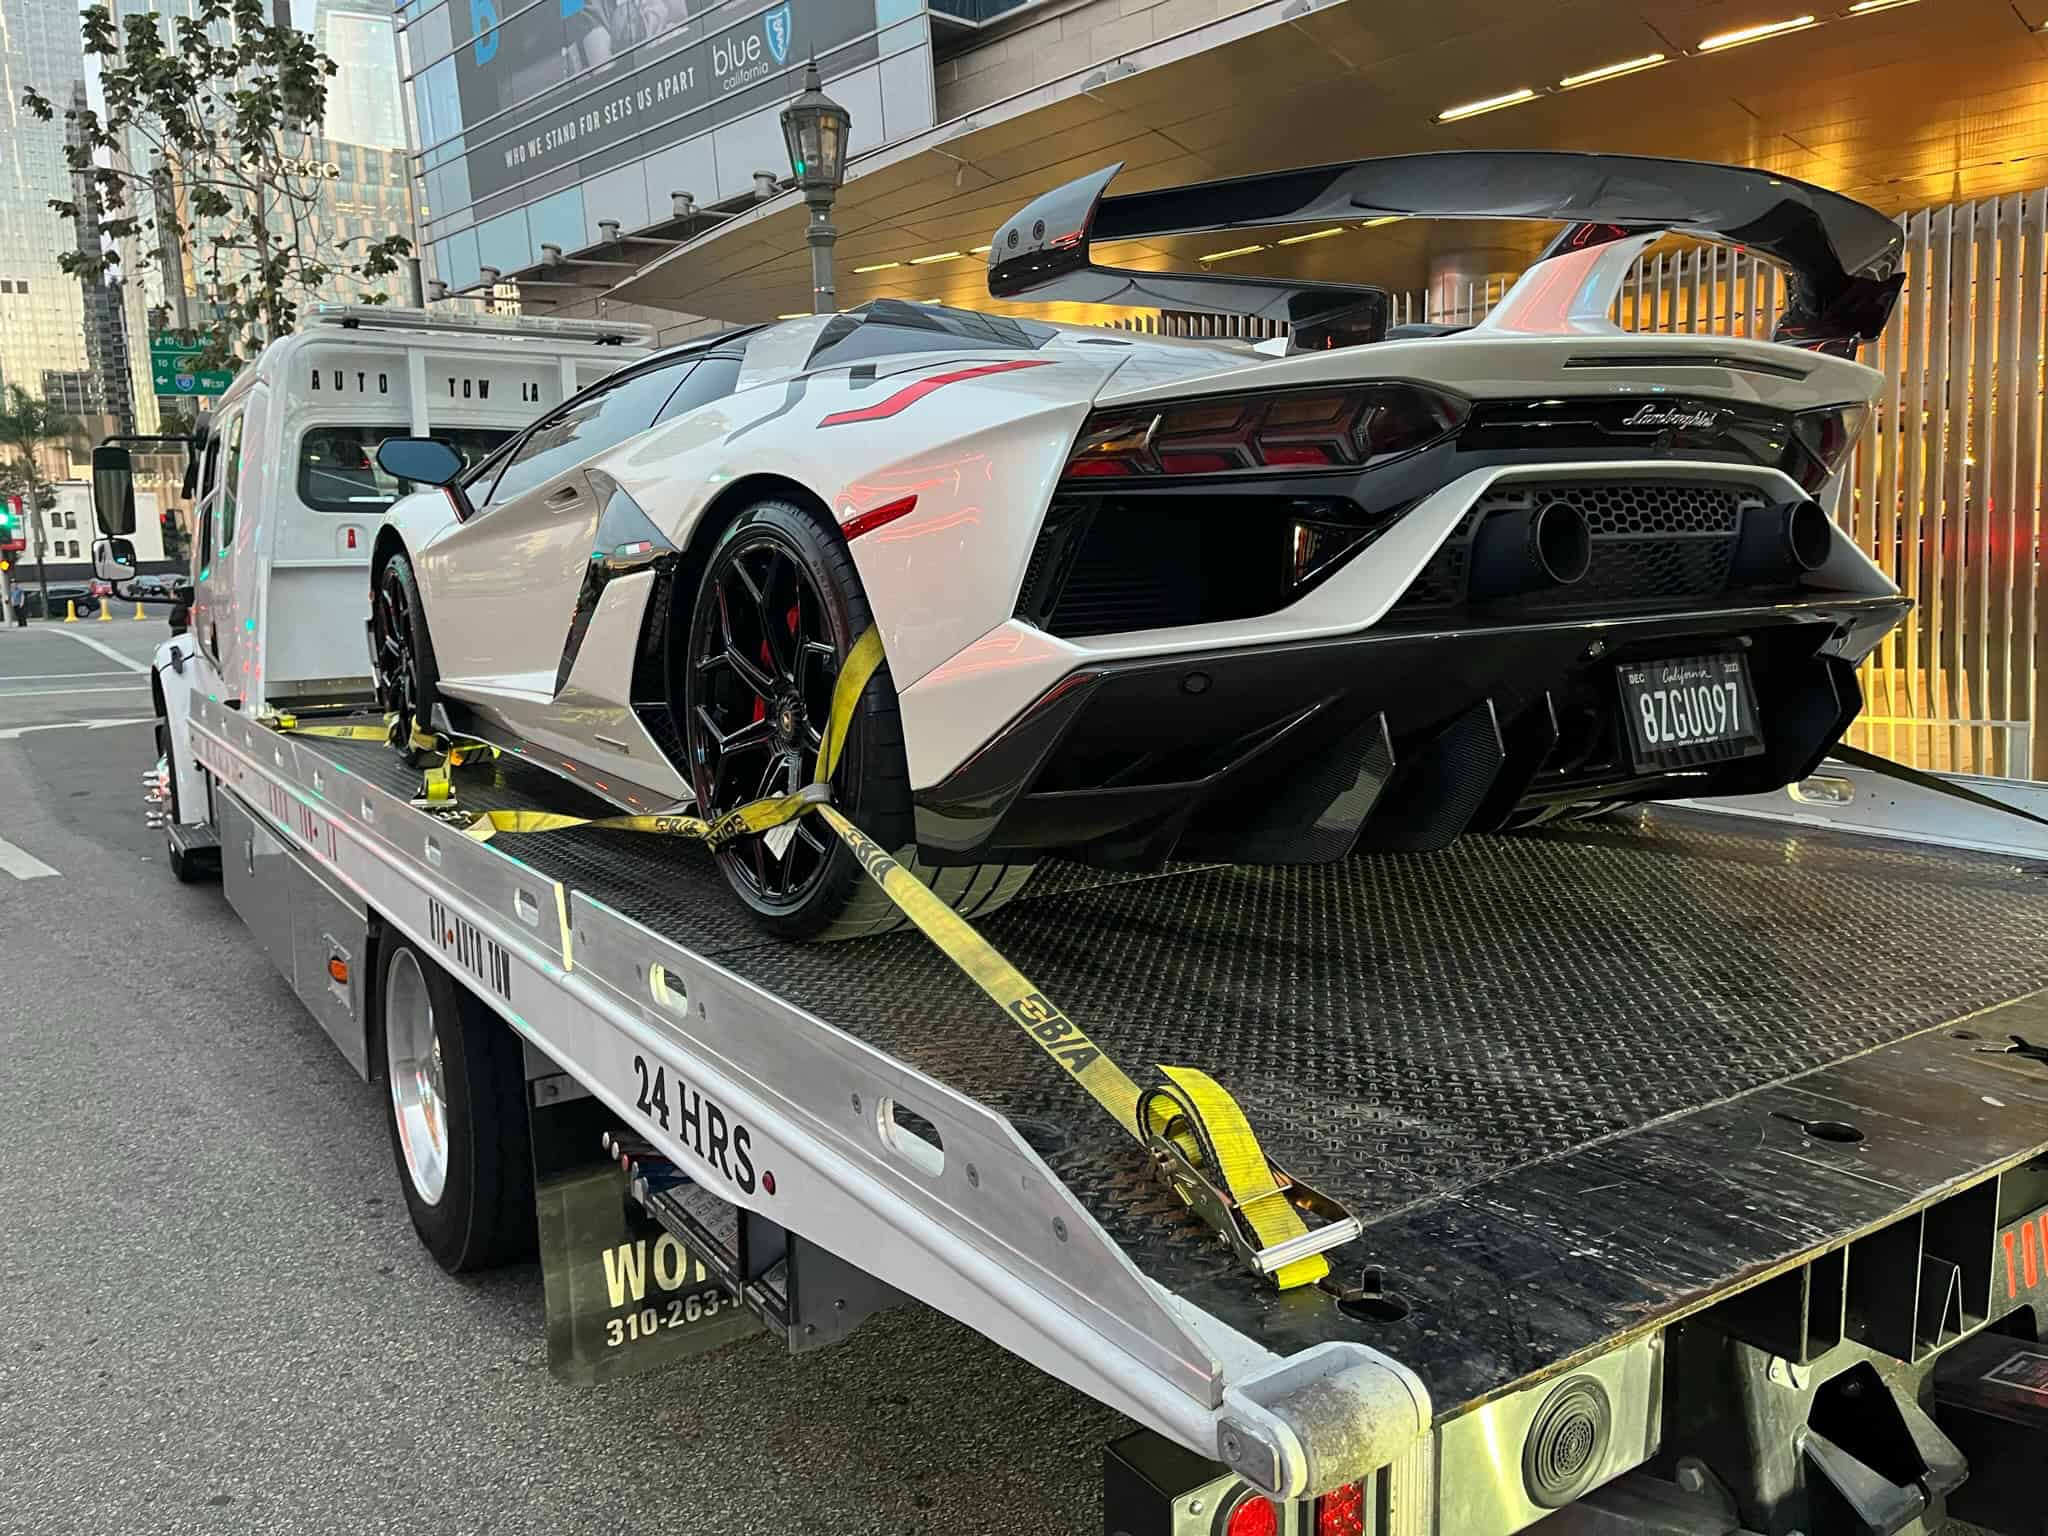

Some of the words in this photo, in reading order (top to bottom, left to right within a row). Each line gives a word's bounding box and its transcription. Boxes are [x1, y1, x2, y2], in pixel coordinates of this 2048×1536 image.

[713, 35, 760, 77] blue
[723, 62, 769, 90] california
[504, 144, 526, 169] WHO
[527, 136, 543, 159] WE
[546, 121, 577, 150] STAND
[580, 111, 600, 137] FOR
[604, 96, 633, 124] SETS
[636, 87, 653, 110] US
[657, 66, 695, 103] APART
[311, 369, 388, 394] AUTO
[448, 378, 490, 399] TOW
[522, 382, 539, 402] LA
[1662, 665, 1712, 685] California
[1639, 681, 1739, 744] 8ZGU097
[634, 1055, 670, 1132] 24
